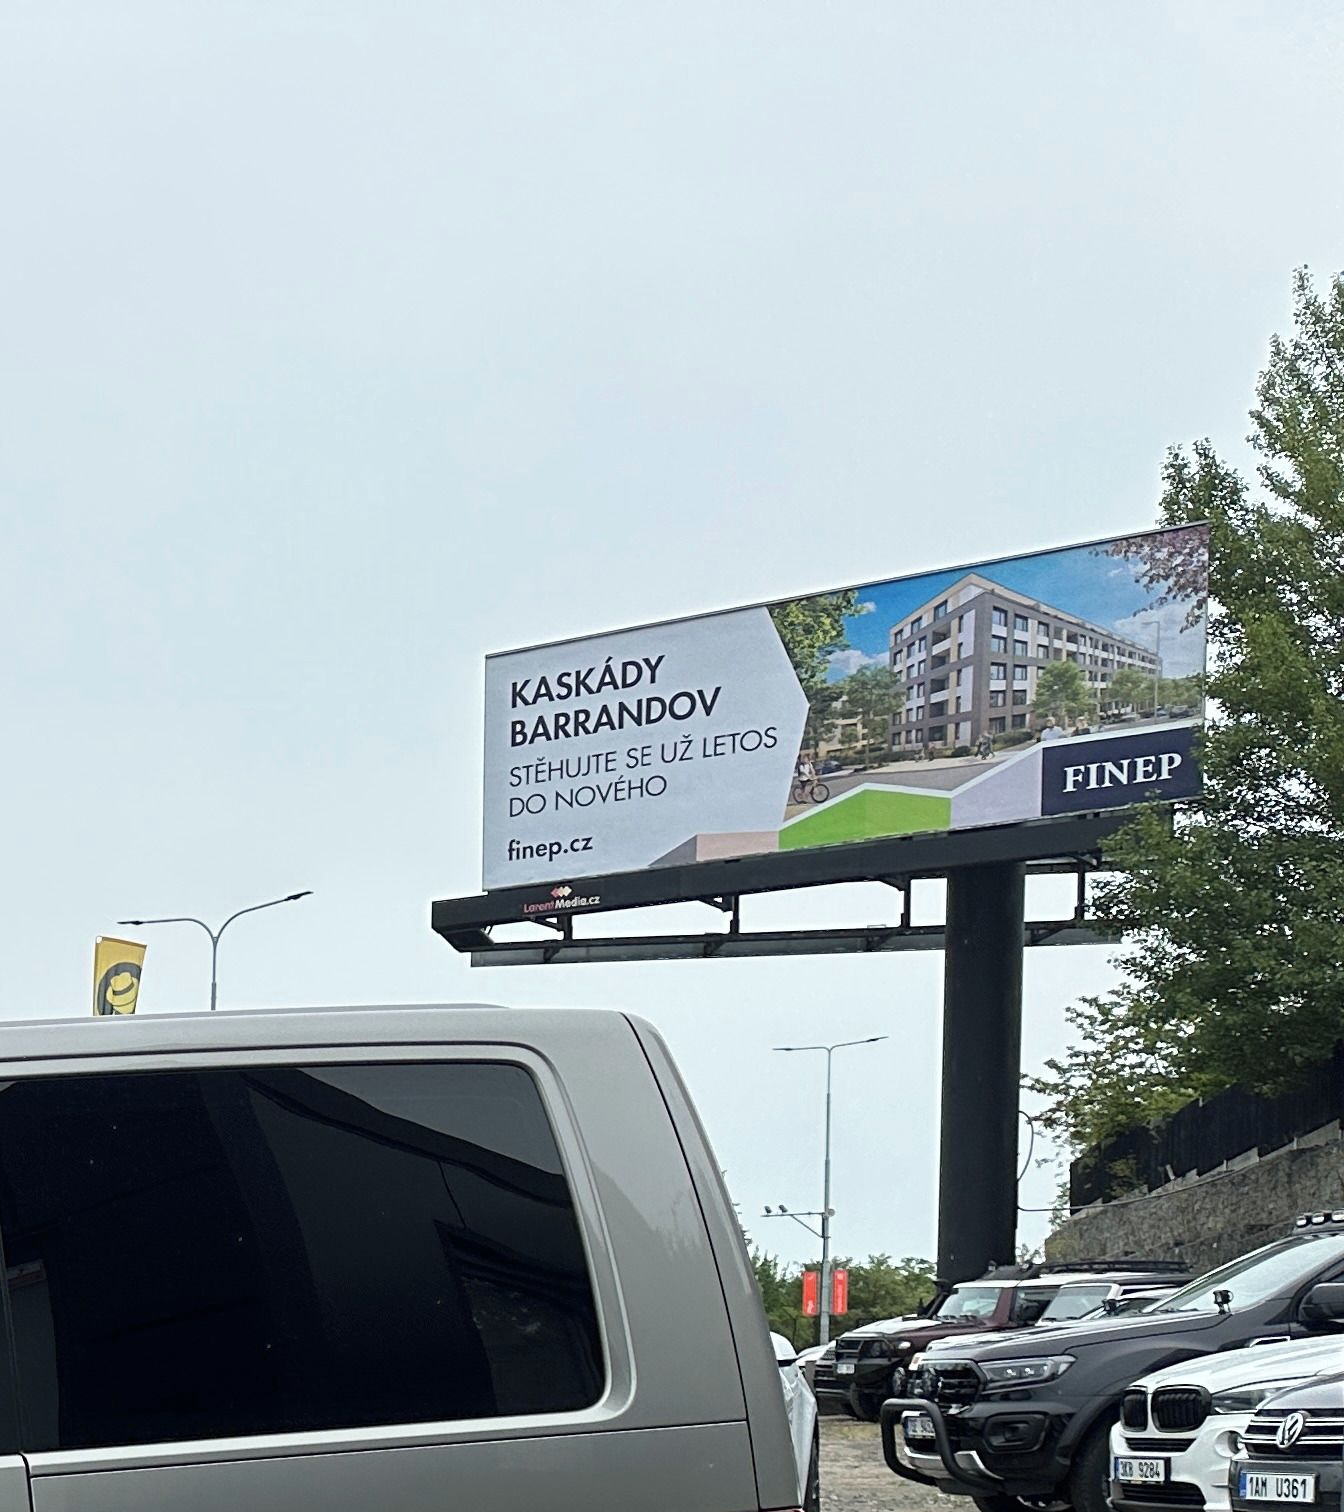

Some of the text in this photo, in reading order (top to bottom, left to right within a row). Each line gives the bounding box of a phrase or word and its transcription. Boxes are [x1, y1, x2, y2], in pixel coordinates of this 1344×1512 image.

[511, 654, 666, 709] KASKÁDY
[510, 686, 722, 748] BARRANDOV
[509, 726, 778, 788] STĚHUJTE SE UŽ LETOS
[1062, 752, 1183, 793] FINEP
[509, 775, 668, 818] DO NOVÉHO
[507, 836, 594, 862] finep.cz
[1138, 1461, 1161, 1478] 9284
[1249, 1476, 1308, 1499] 1AM U361
